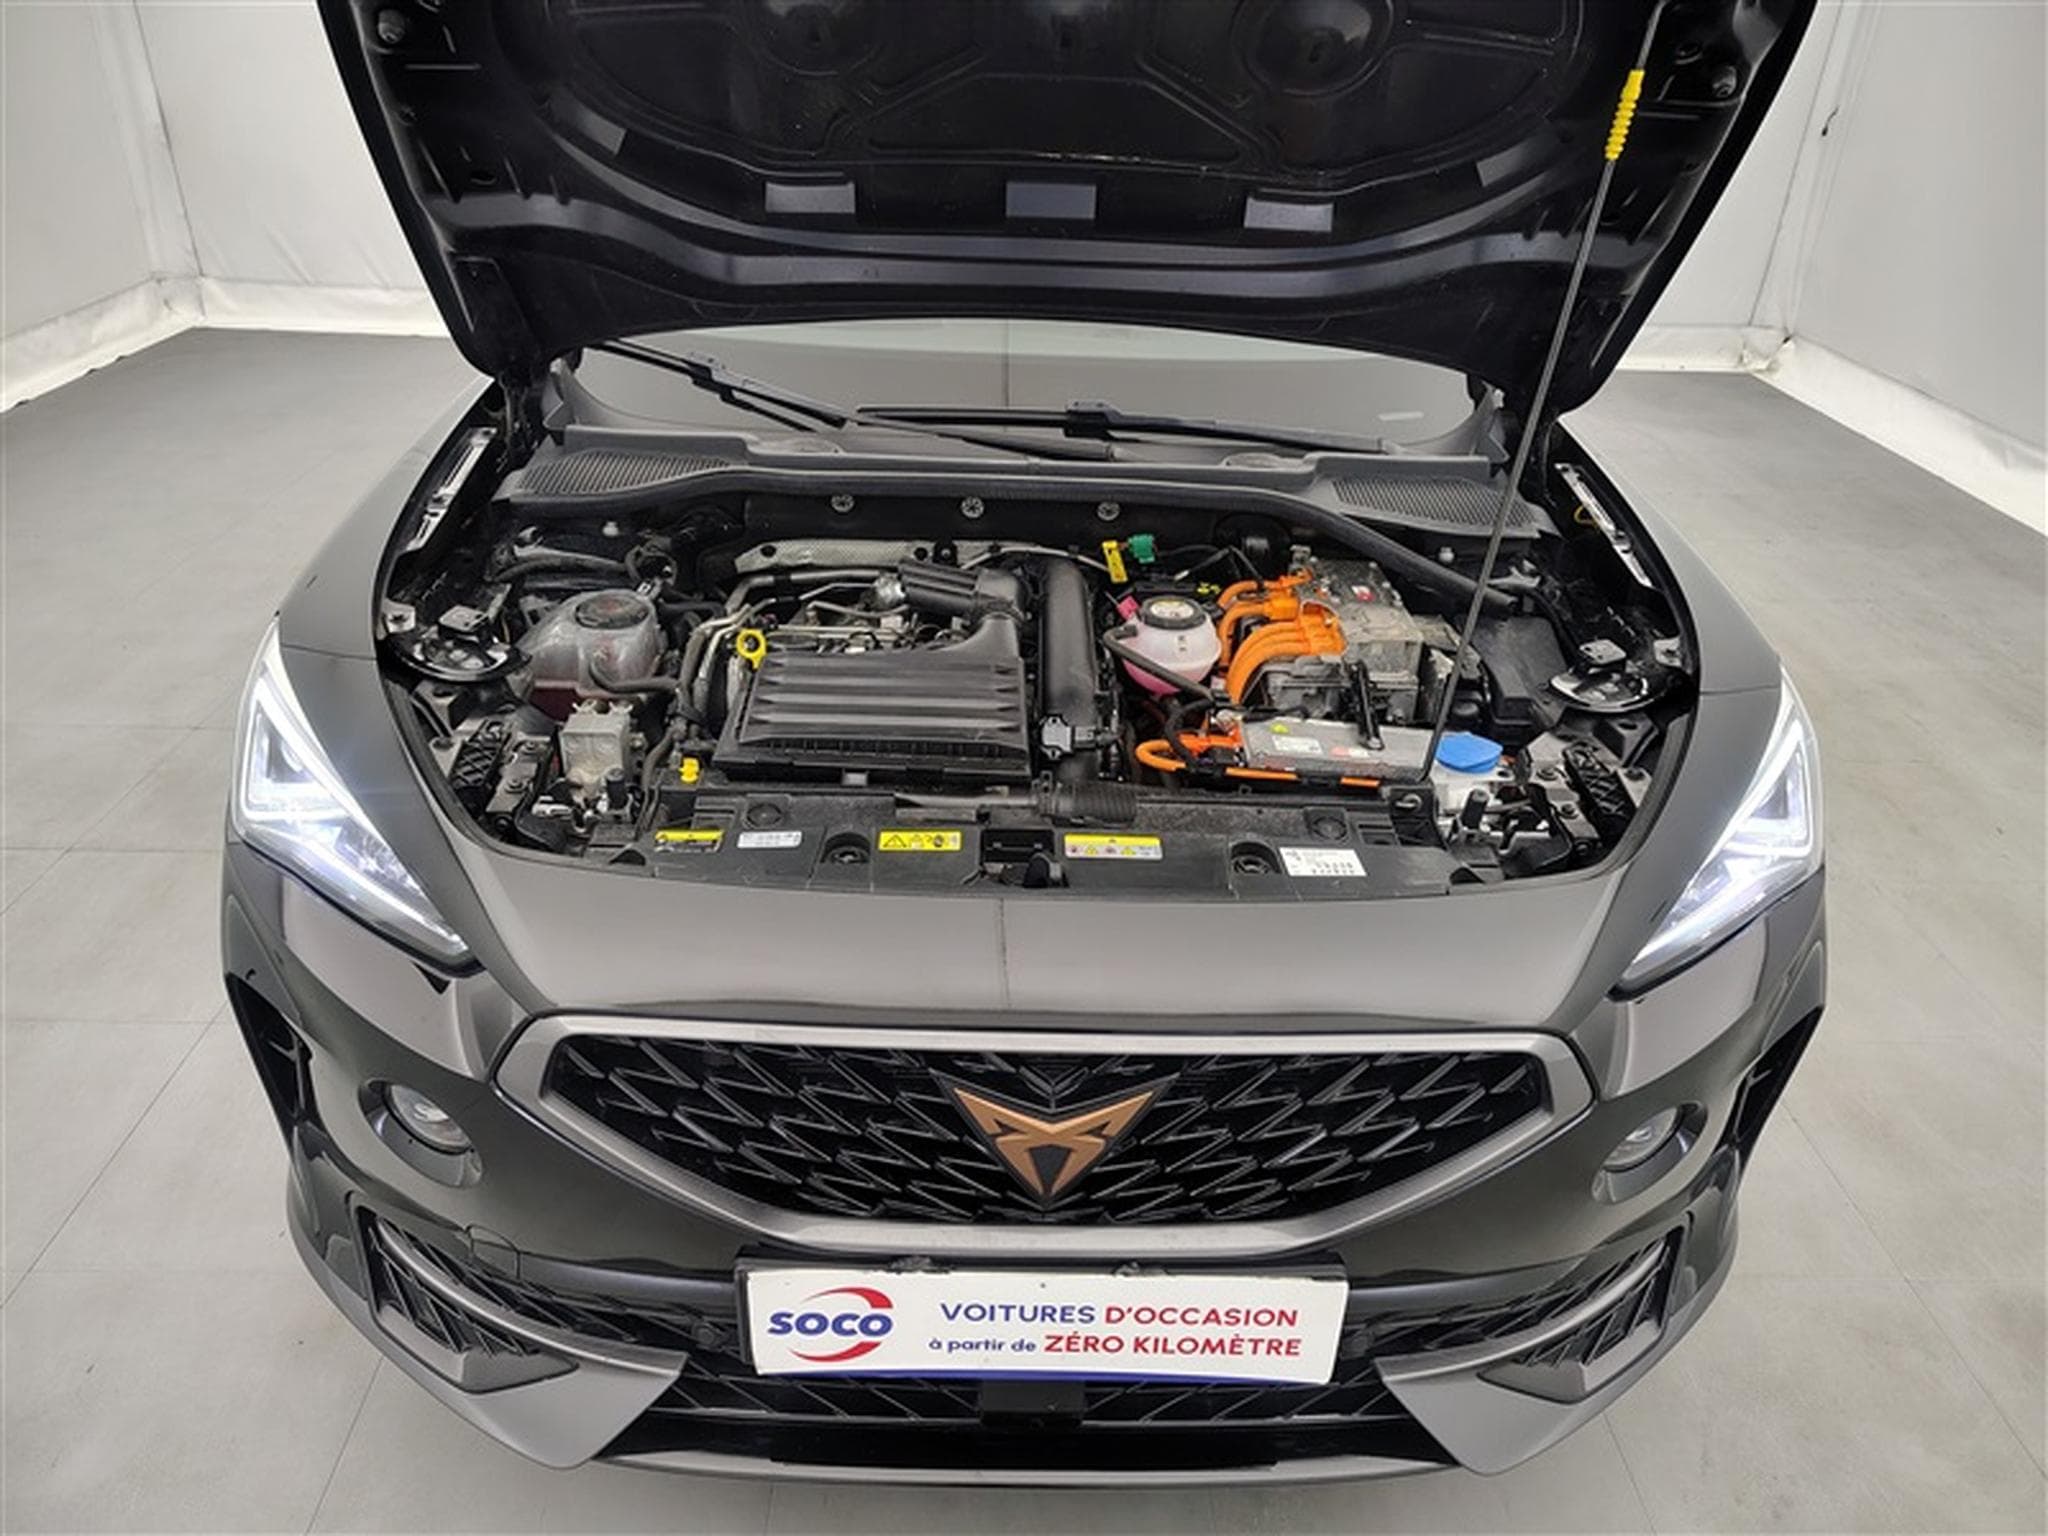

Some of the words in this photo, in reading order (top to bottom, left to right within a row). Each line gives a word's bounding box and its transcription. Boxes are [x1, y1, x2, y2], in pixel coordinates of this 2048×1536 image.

[769, 1311, 892, 1337] SOCO
[941, 1303, 1095, 1324] VOITURES
[1105, 1306, 1298, 1327] D'OCCASION
[929, 1338, 942, 1350] à
[948, 1338, 1006, 1353] partir
[1014, 1337, 1036, 1352] de
[1044, 1331, 1124, 1354] ZÉRO
[1133, 1334, 1302, 1356] KILOMÈTRE
